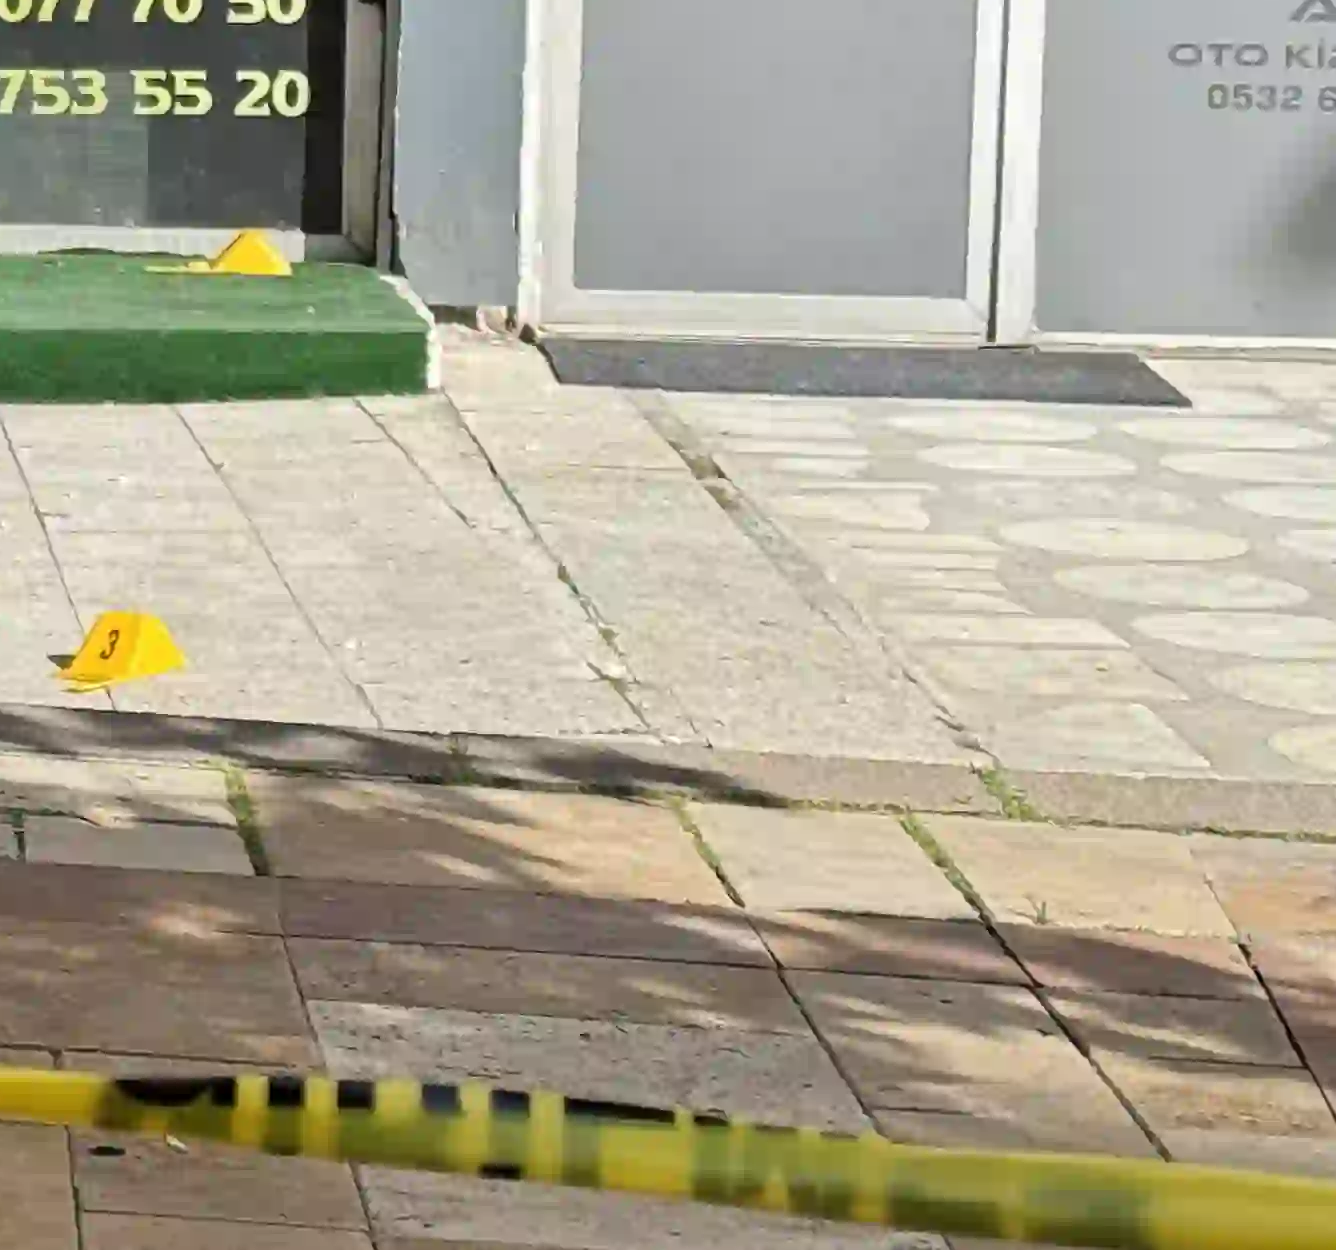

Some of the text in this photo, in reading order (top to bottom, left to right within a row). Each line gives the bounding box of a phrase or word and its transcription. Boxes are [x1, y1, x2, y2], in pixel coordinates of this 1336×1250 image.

[1167, 36, 1336, 69] OTO Kİ
[129, 68, 214, 118] 55
[233, 68, 312, 120] 20
[1207, 83, 1304, 111] 0532
[99, 629, 121, 660] 3
